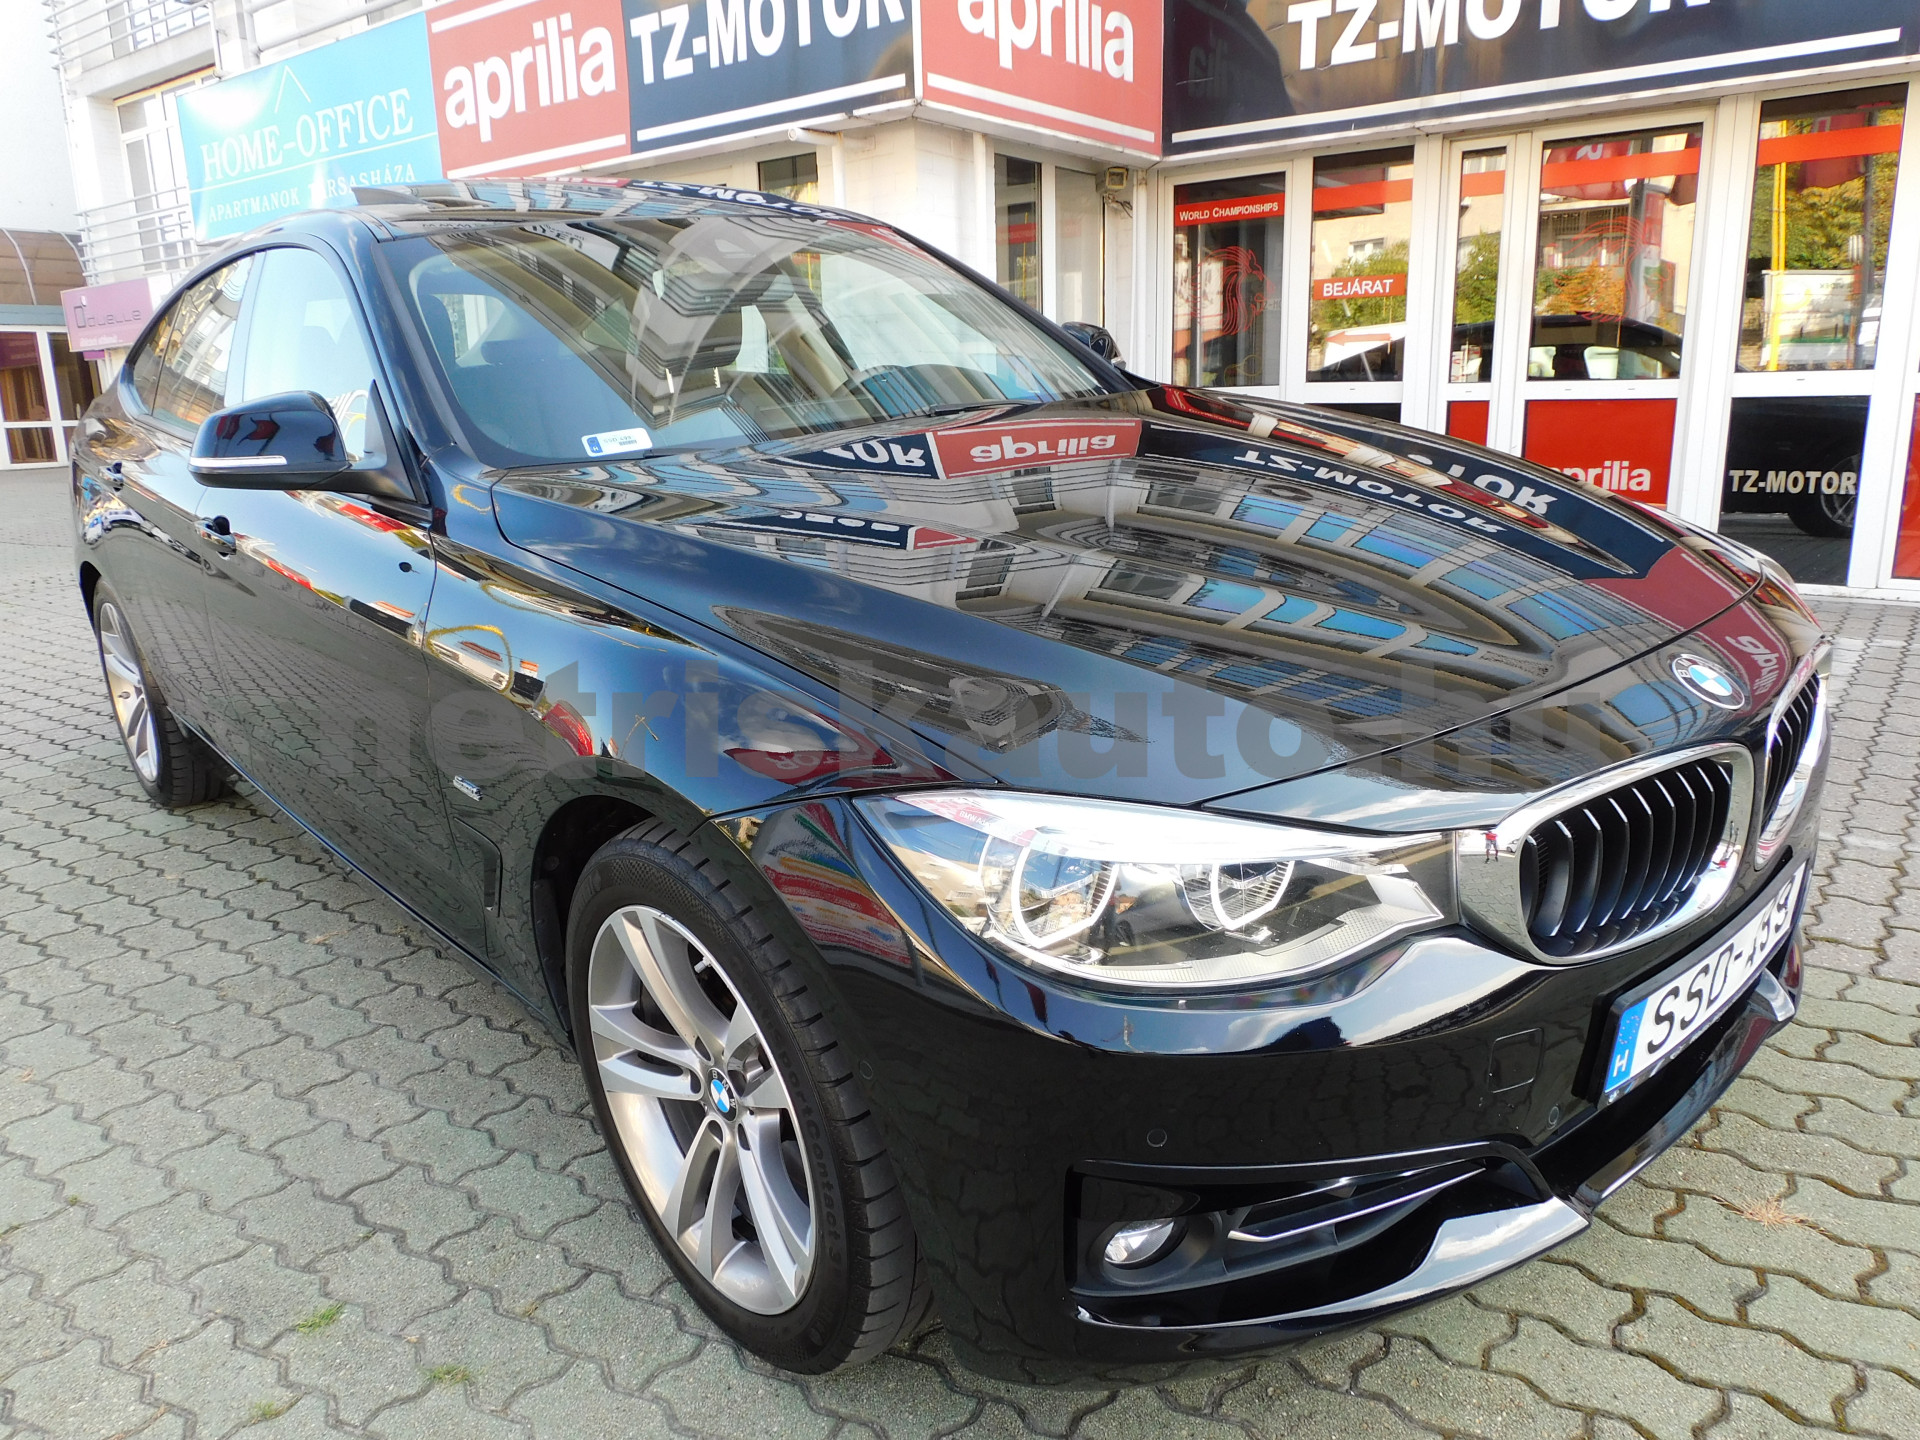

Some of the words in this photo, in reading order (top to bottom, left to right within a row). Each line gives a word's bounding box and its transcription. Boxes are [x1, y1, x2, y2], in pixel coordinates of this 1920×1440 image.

[957, 0, 1134, 83] aprilia
[1287, 0, 1711, 71] TZ-MO
[443, 12, 617, 143] aprilia
[201, 88, 414, 182] HOME-OFFICE
[208, 187, 300, 223] APARTMANOK
[308, 163, 417, 202] TRSASHÁZA
[1180, 210, 1210, 221] WORLD
[1213, 202, 1279, 218] CHAMPIONSHIPS
[1323, 278, 1394, 297] BEJÁRAT
[1729, 469, 1858, 495] TZ-MOTOR
[1612, 1049, 1630, 1077] H
[711, 1070, 736, 1109] BMW
